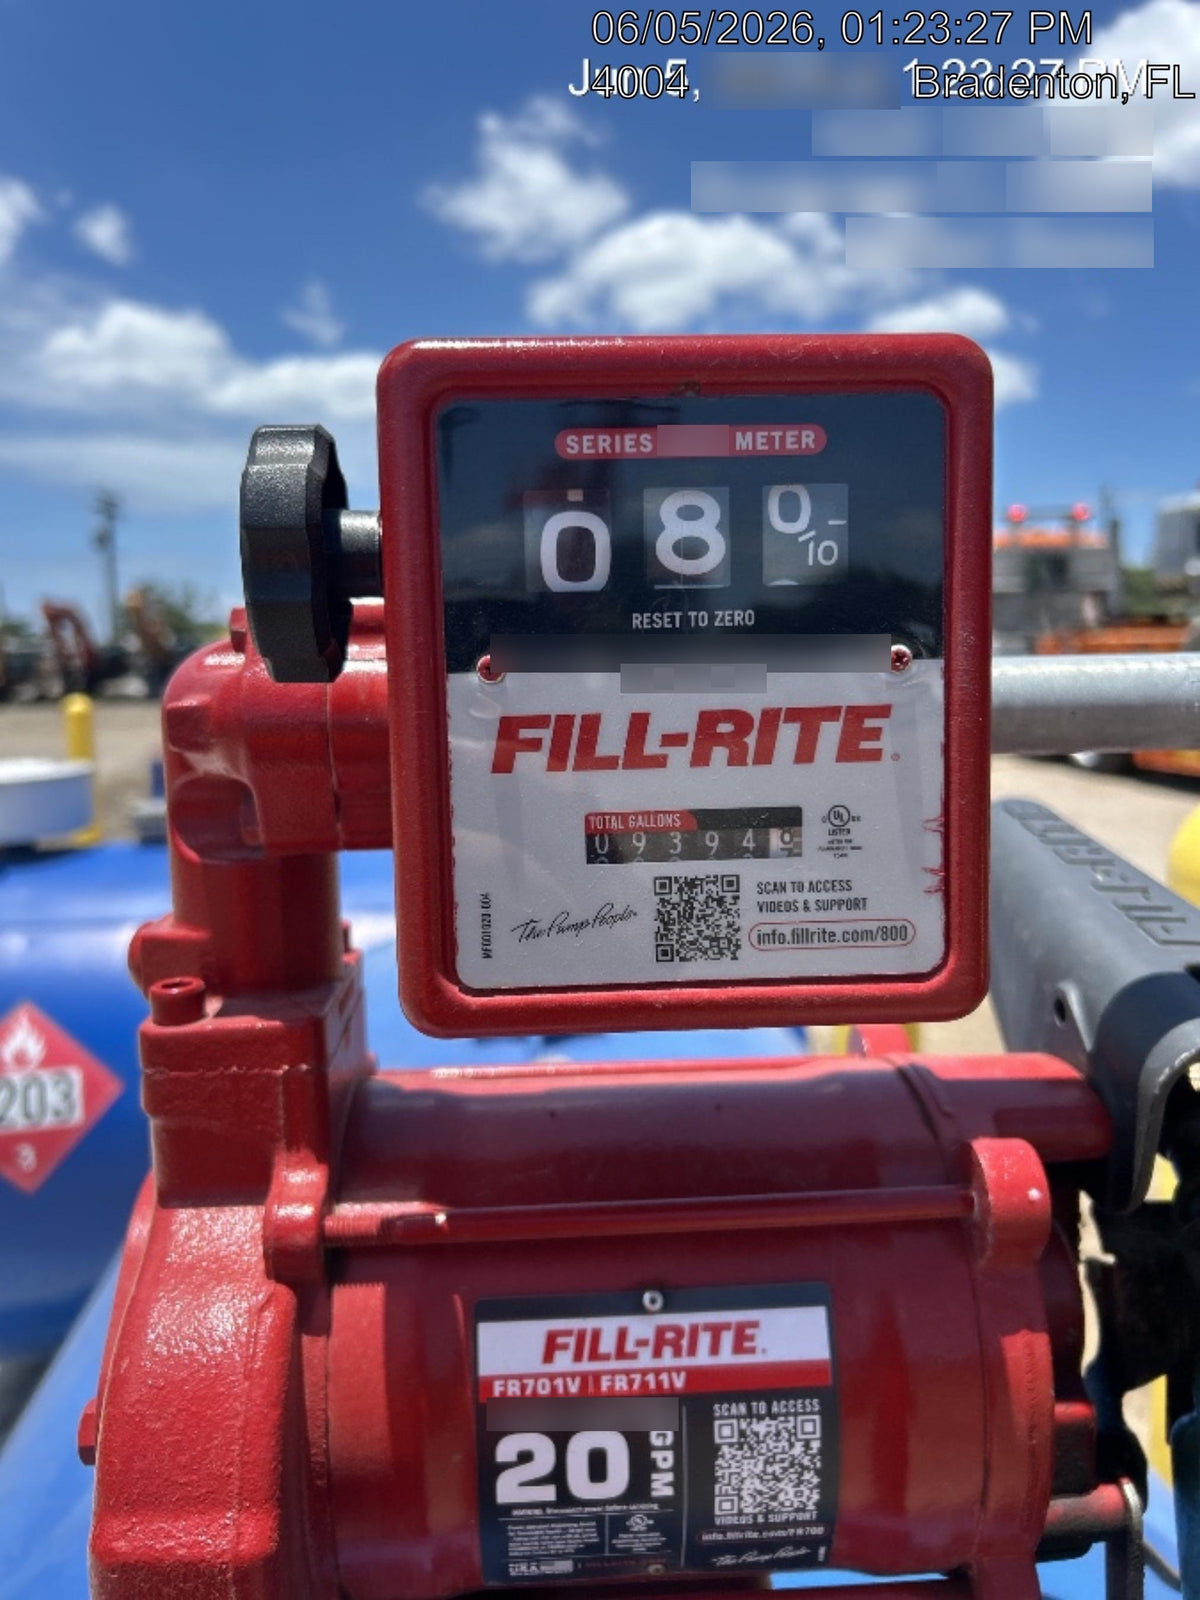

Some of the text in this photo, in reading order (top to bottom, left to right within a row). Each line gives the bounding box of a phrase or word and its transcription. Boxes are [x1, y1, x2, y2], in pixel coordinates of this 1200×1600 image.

[566, 430, 817, 454] SERIES METER
[632, 609, 755, 629] RESET TO ZERO
[491, 704, 892, 774] FILL-RITE
[588, 813, 682, 830] TOTAL GALLONS
[756, 879, 853, 895] SCAN TO ACCESS
[756, 897, 868, 913] VIDEOS & SUPPORT
[756, 924, 909, 946] info.fillrite.com/800
[541, 1320, 760, 1364] FILL-RITE
[493, 1371, 687, 1397] FR701V FR711V
[713, 1398, 820, 1417] SCAN TO ACCESS
[495, 1430, 630, 1504] 20
[649, 1430, 675, 1497] GPM
